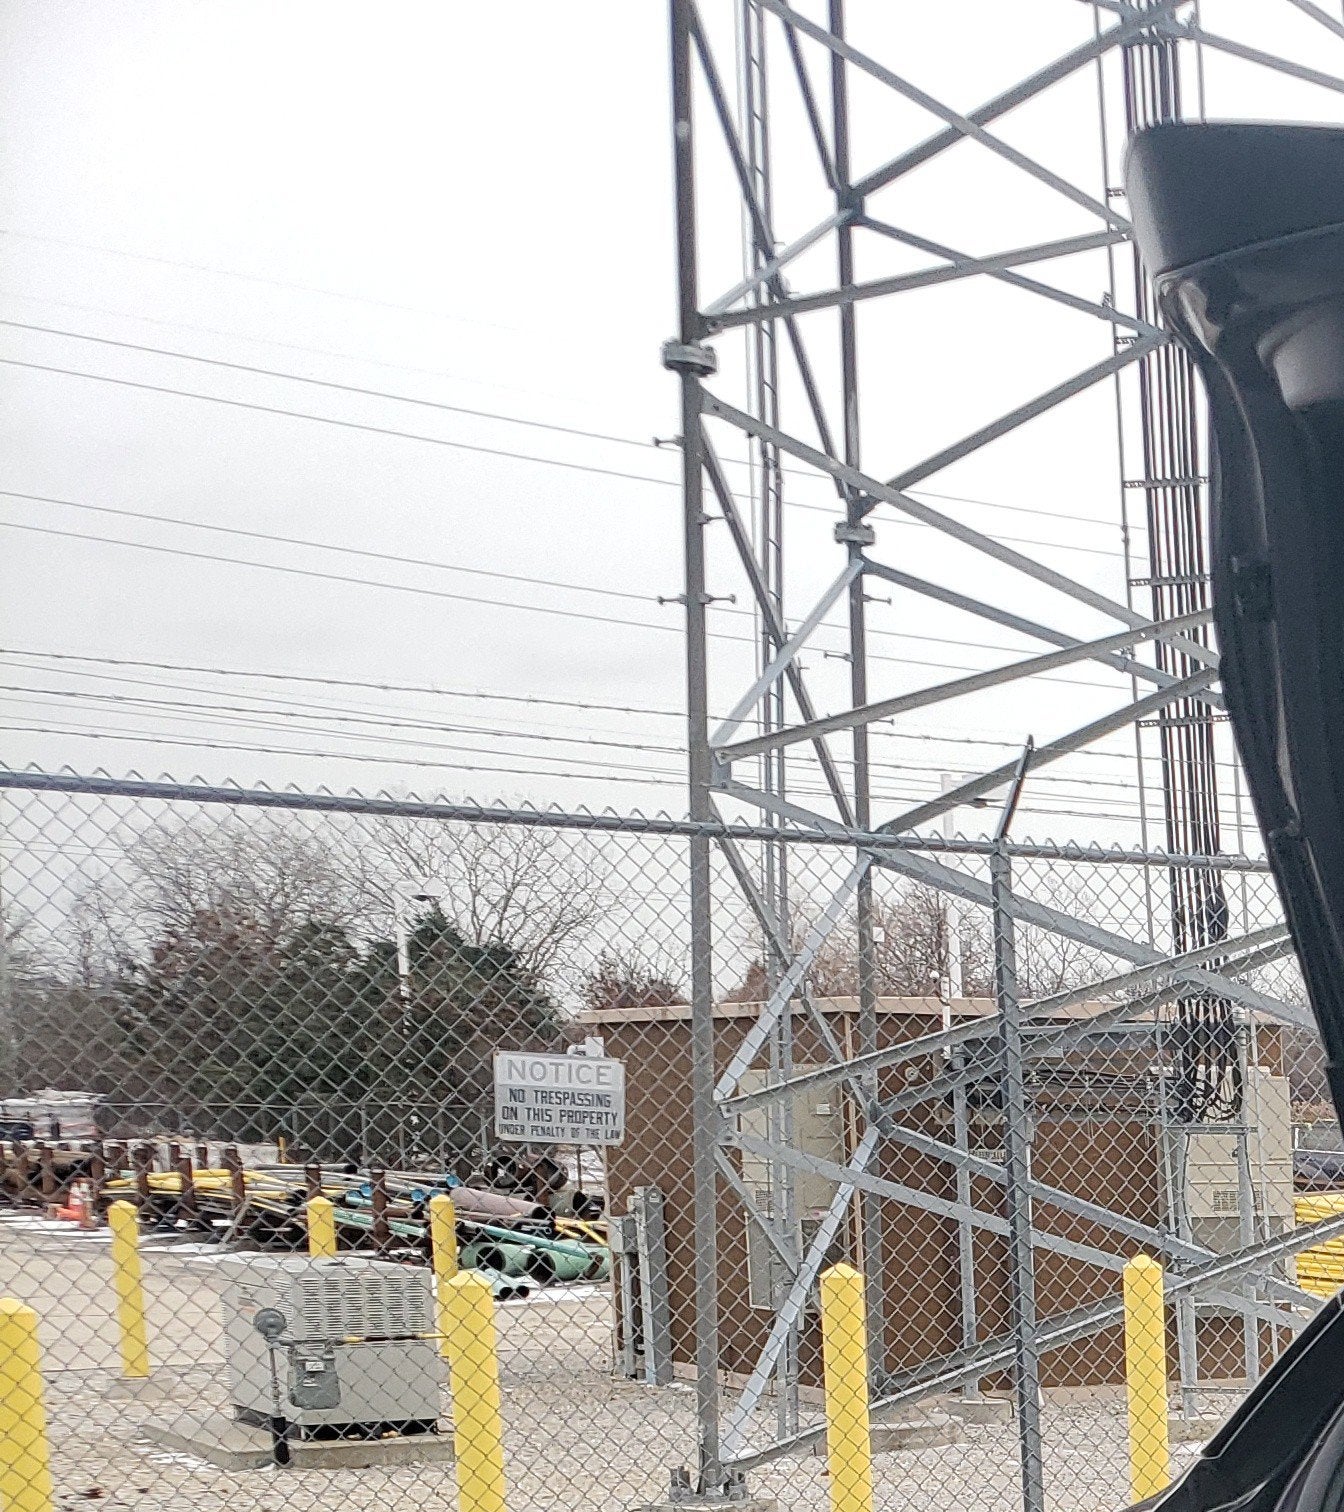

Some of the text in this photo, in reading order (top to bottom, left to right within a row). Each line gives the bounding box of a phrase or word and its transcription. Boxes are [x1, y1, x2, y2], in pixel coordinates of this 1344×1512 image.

[507, 1059, 613, 1086] NOTICE
[509, 1088, 612, 1108] NO TRESPASSING
[501, 1105, 618, 1127] ON THIS PROPERTY
[499, 1123, 621, 1140] UNDER PENALTY OF THE LAW
